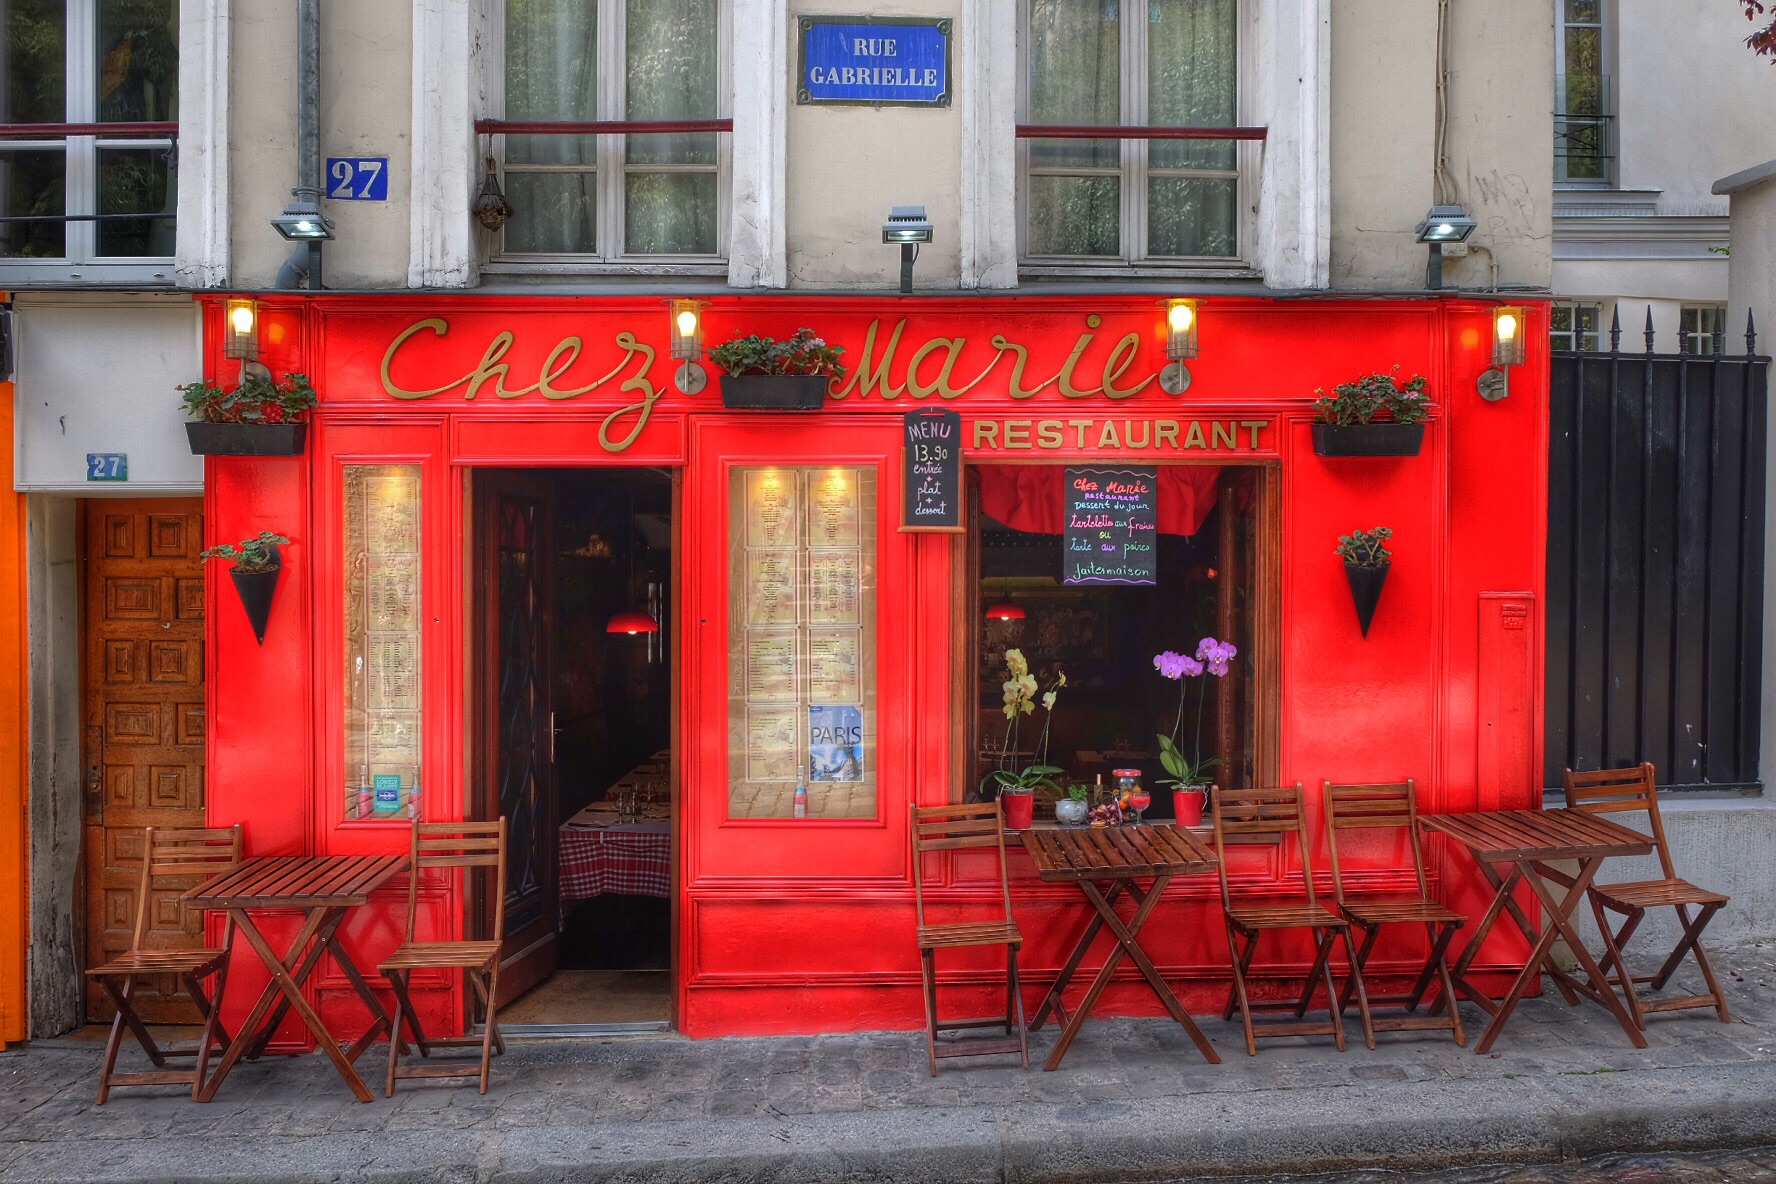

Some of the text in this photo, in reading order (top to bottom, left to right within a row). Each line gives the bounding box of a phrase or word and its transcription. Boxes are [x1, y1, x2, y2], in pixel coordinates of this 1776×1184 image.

[853, 38, 897, 57] RUE
[810, 66, 937, 87] GABRIELLE
[331, 161, 382, 198] 27
[380, 314, 1159, 453] Chez Marie
[908, 421, 951, 442] MENU
[973, 420, 1269, 450] RESTAURANT
[914, 444, 948, 462] 13.90
[93, 456, 120, 477] 27
[913, 461, 943, 475] entrée
[917, 481, 942, 501] plat
[1073, 477, 1150, 495] Chez Marie
[915, 501, 947, 516] dessert
[1074, 500, 1111, 511] Dessert
[1114, 520, 1128, 528] aux
[1099, 531, 1112, 539] ou
[1069, 537, 1151, 560] tarte aux poires
[810, 726, 862, 746] PARIS
